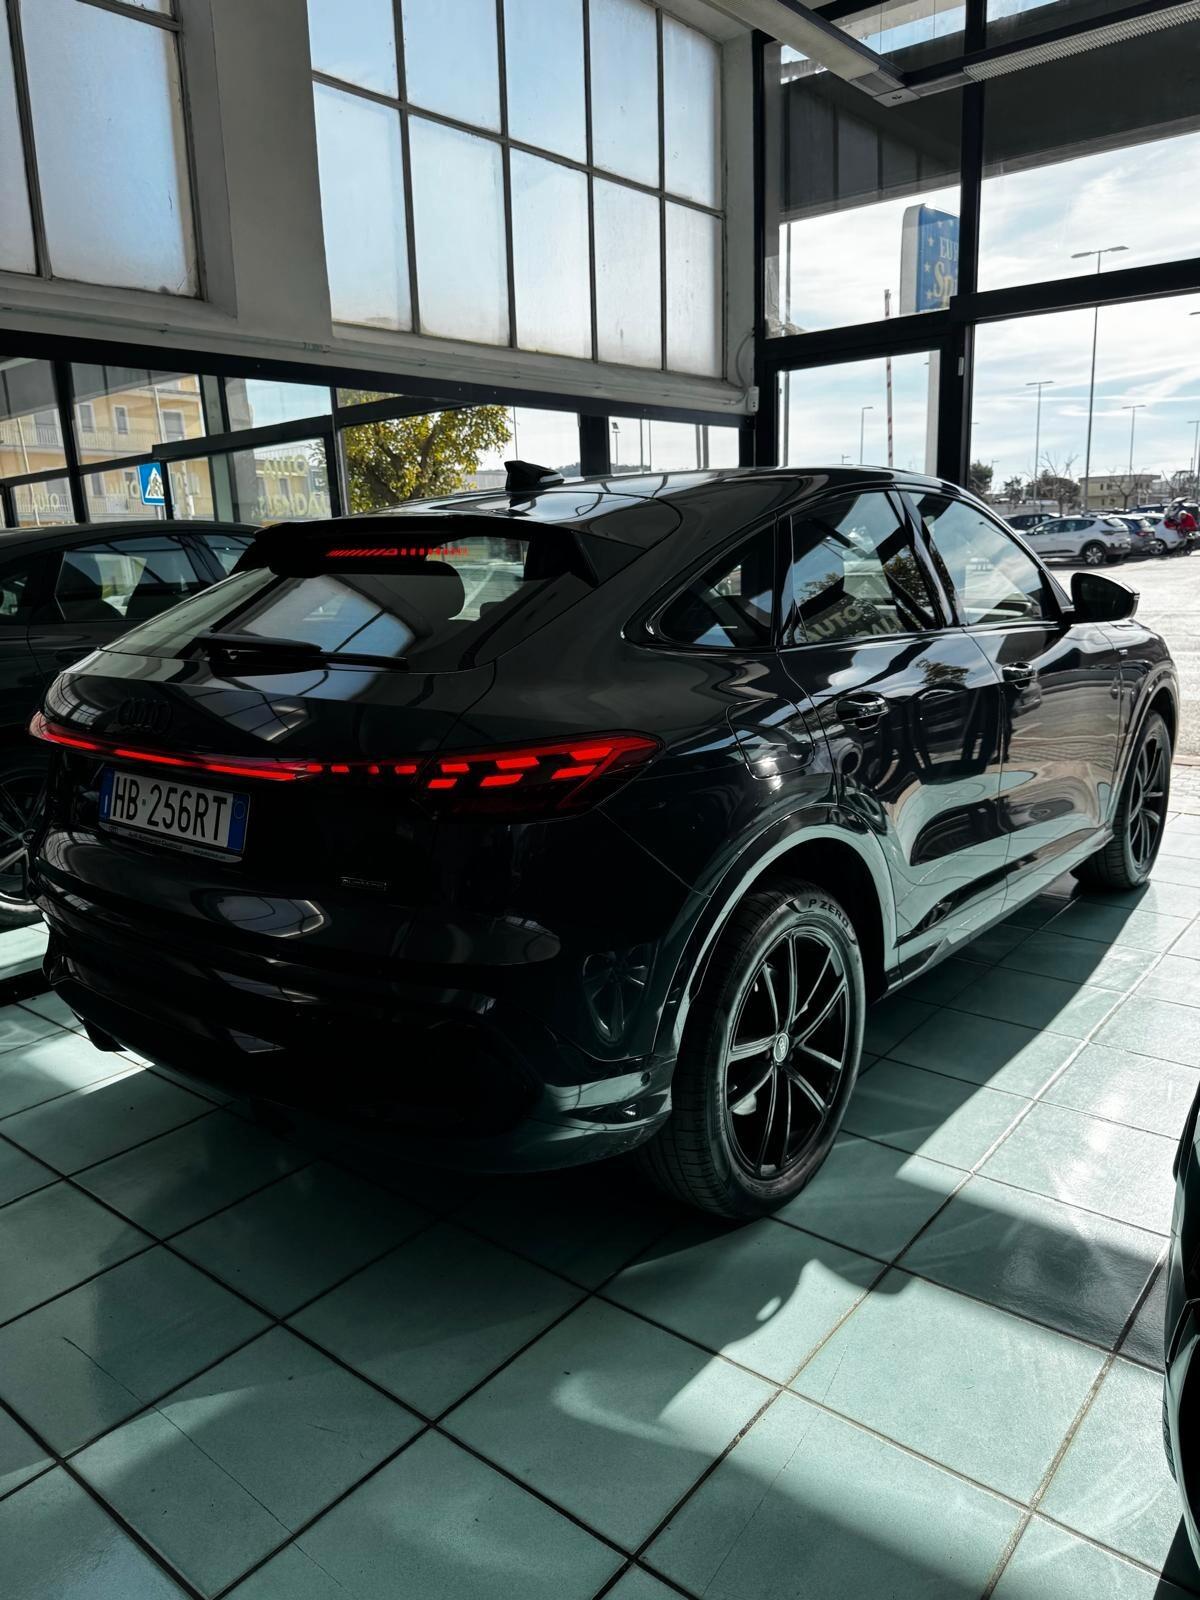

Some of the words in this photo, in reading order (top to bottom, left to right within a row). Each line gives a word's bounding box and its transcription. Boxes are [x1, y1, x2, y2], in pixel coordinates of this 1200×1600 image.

[113, 776, 140, 821] HB
[147, 784, 228, 840] 256RT
[808, 899, 817, 909] P
[819, 900, 849, 929] ZERO
